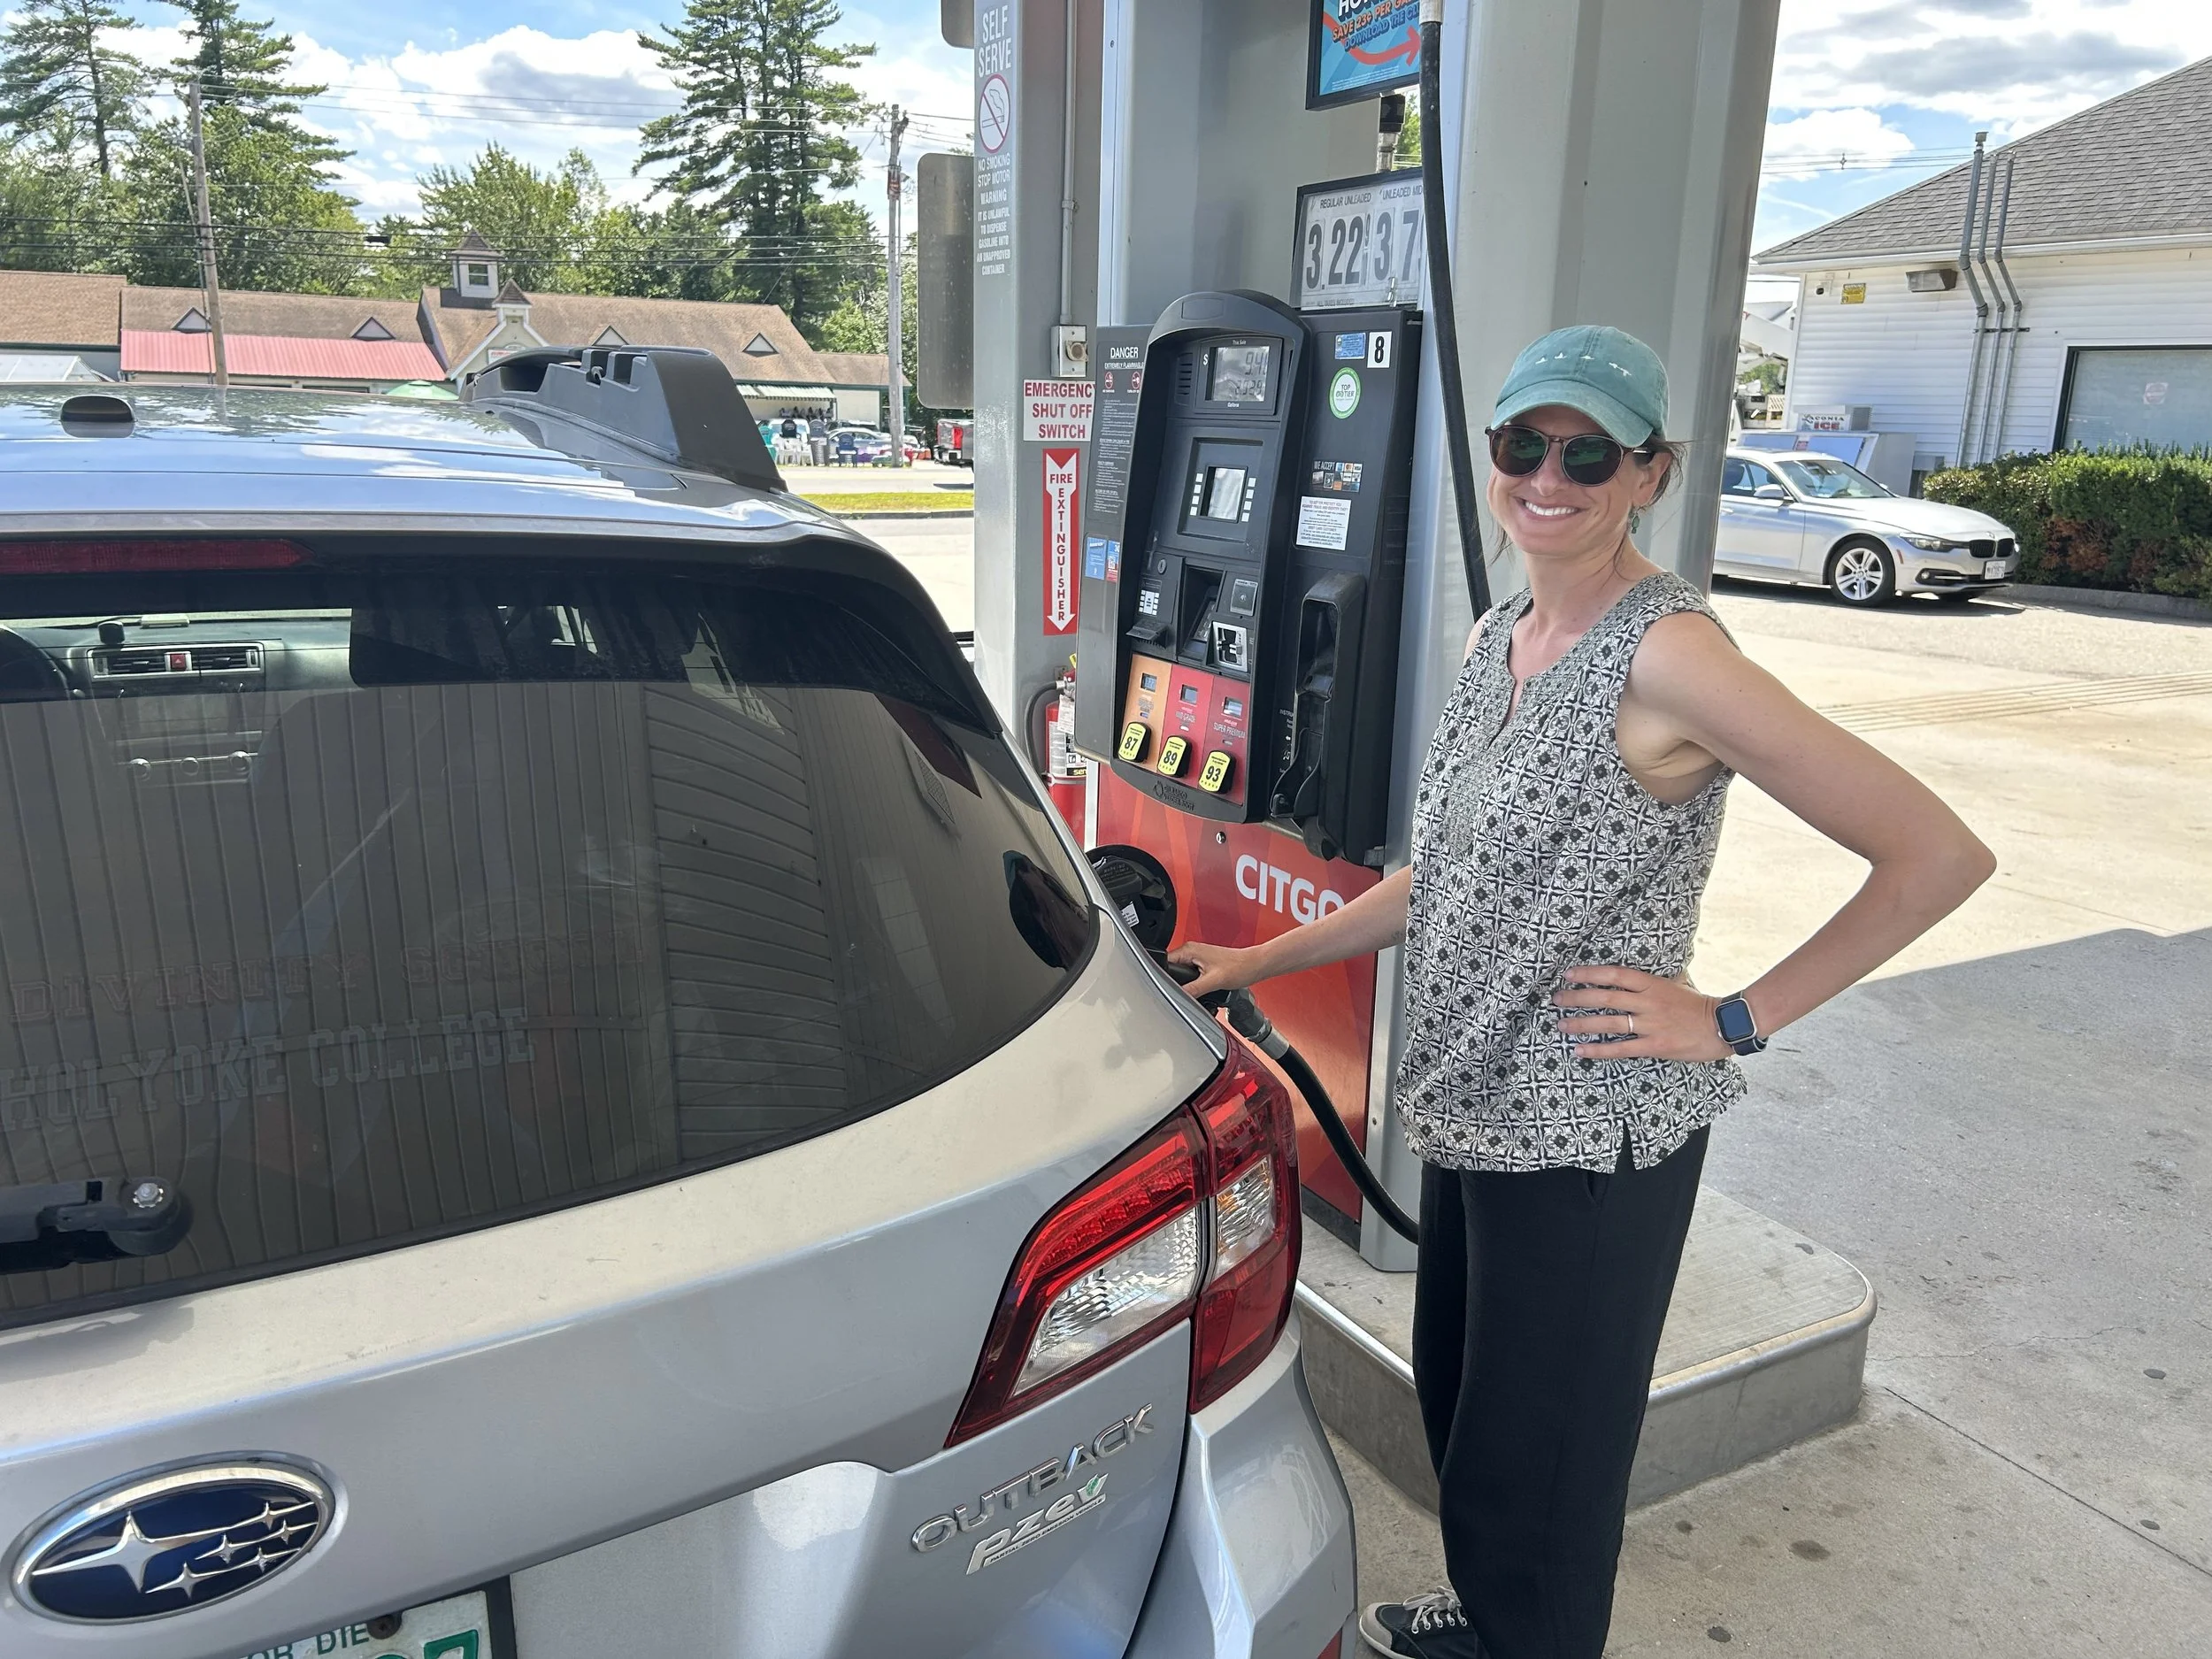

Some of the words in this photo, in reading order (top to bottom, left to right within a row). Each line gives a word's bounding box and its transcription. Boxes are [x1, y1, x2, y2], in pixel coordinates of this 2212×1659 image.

[982, 4, 1008, 43] SELF
[1333, 19, 1354, 41] SAVE
[1356, 12, 1372, 28] 23¢
[1374, 1, 1392, 18] PER
[1345, 20, 1388, 49] DOWNLOAD
[1391, 10, 1405, 27] THE
[978, 37, 1011, 78] SERVE
[978, 158, 986, 172] NO
[986, 152, 1010, 170] SMOKING
[978, 173, 991, 188] STOP
[991, 168, 1010, 185] MOTOR
[980, 188, 1007, 204] WARNING
[1320, 196, 1344, 209] REGULAR
[1344, 192, 1371, 206] UNLEADED
[1382, 188, 1411, 201] UNLEADED
[978, 211, 982, 222] IT
[982, 211, 987, 221] IS
[980, 224, 987, 234] TO
[987, 221, 1007, 234] DISPENSE
[978, 236, 998, 249] GASOLINE
[976, 252, 982, 263] AN
[1110, 346, 1139, 359] DANGER
[1374, 335, 1385, 364] 8
[1202, 353, 1209, 365] $
[1032, 403, 1066, 419] SHUT
[1070, 403, 1092, 419] OFF
[1039, 424, 1086, 439] SWITCH
[1813, 421, 1840, 430] ICE
[1321, 461, 1335, 470] ACCEPT
[1049, 473, 1073, 484] FIRE
[1056, 488, 1066, 621] EXTINGUISHER
[1213, 722, 1227, 733] SUPER
[1226, 725, 1246, 739] PREMIUM
[1124, 736, 1139, 751] 87
[1163, 750, 1178, 765] 89
[1205, 765, 1222, 782] 93
[307, 1007, 536, 1087] COLLEGE
[910, 1402, 1155, 1553] OUTBACK
[989, 1545, 1019, 1563] PARTIAL
[1021, 1532, 1041, 1547] ZERO
[1041, 1514, 1075, 1536] EMISSION
[1075, 1499, 1103, 1517] VEHICLE
[315, 1622, 370, 1655] DIE
